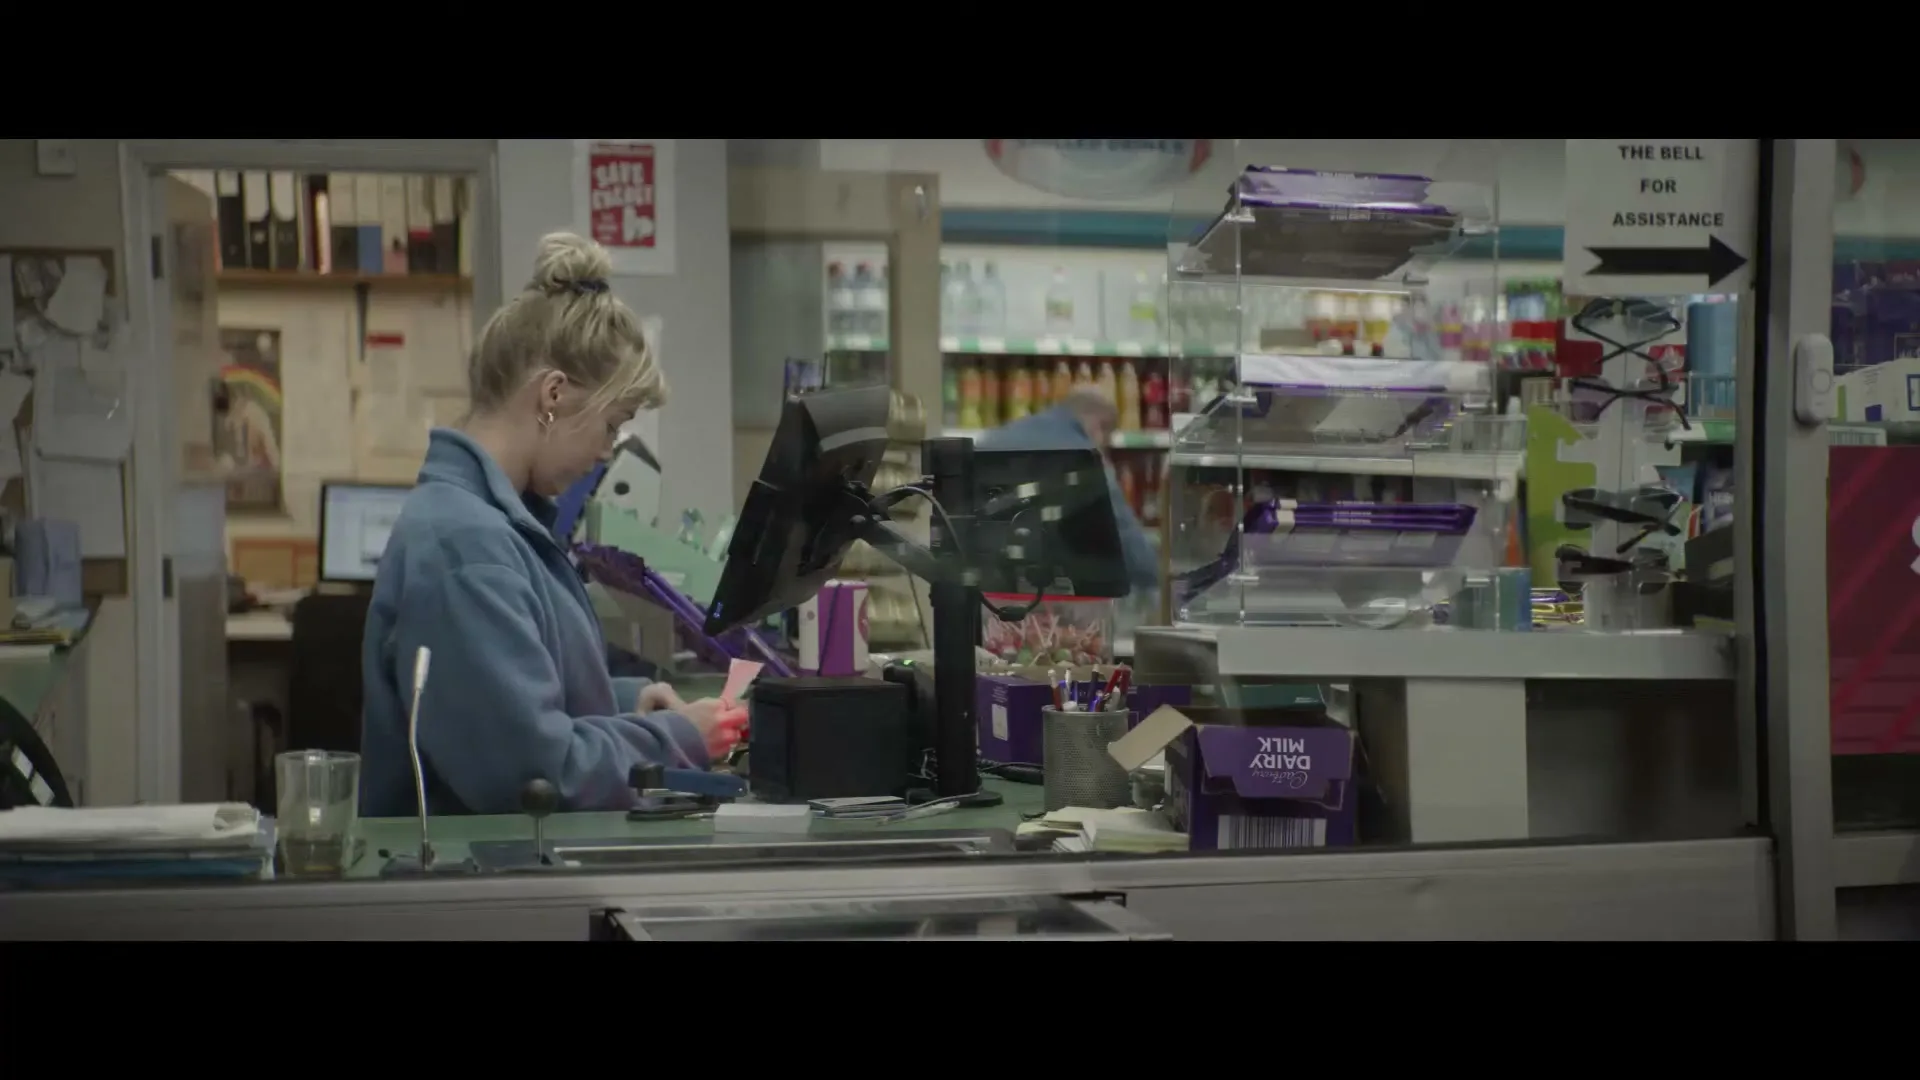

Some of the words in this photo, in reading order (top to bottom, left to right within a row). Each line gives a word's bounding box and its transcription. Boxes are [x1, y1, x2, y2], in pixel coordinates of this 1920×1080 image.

[1618, 145, 1655, 160] THE
[1660, 145, 1704, 161] BELL
[1640, 178, 1677, 194] FOR
[1612, 211, 1725, 227] ASSISTANCE
[1256, 736, 1305, 753] MILK
[1248, 753, 1311, 770] DAIRY
[1252, 768, 1309, 790] Cadbury
